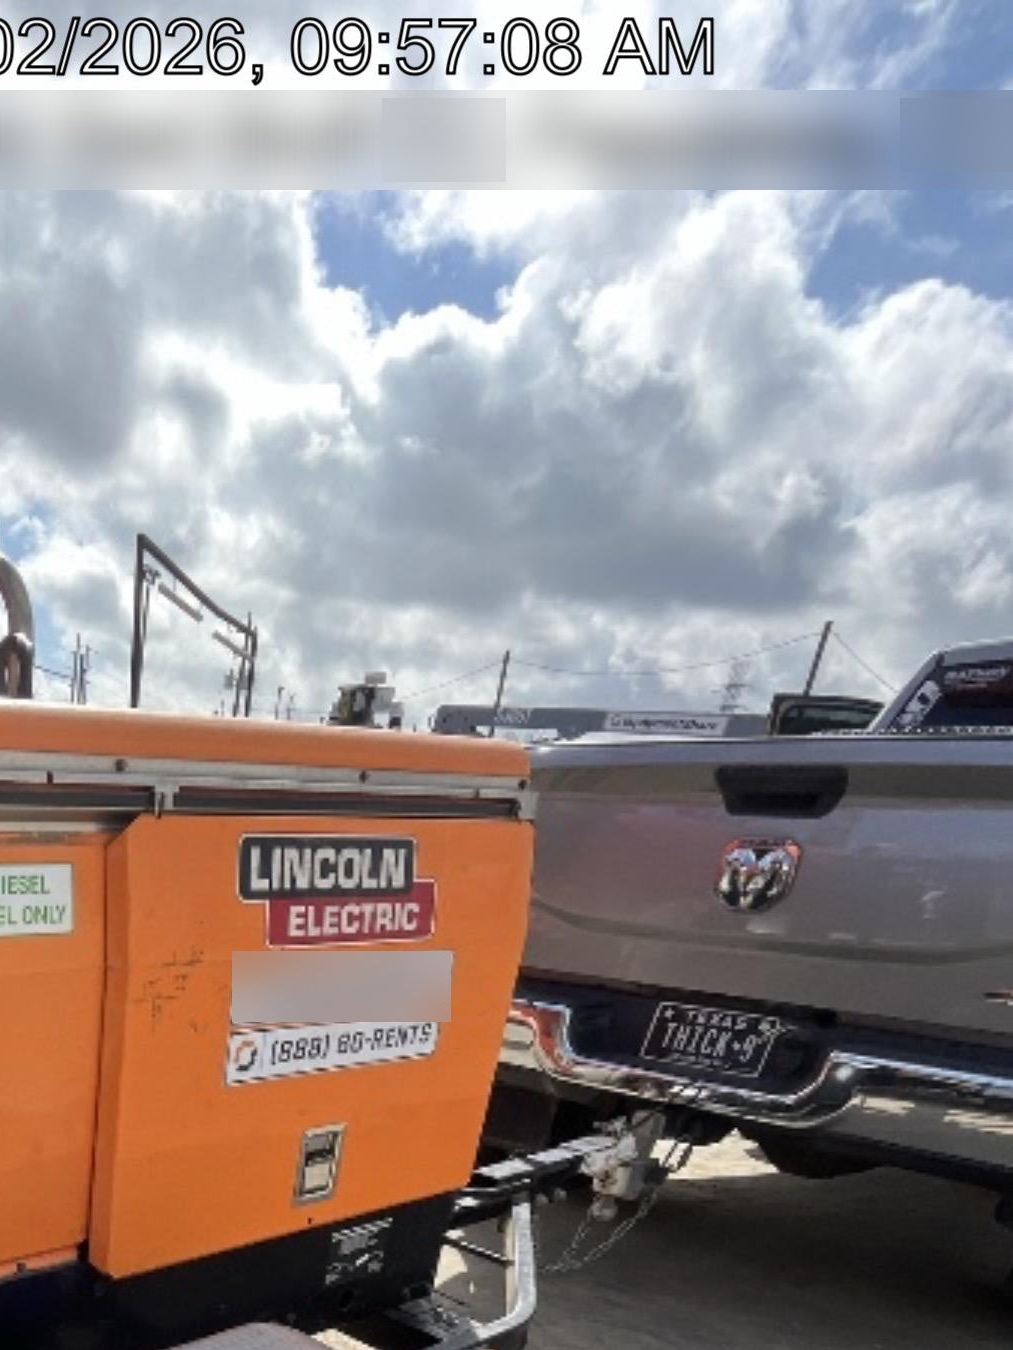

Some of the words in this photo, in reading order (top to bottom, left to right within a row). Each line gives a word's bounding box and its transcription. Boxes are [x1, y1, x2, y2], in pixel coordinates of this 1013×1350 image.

[249, 845, 408, 892] LINCOLN
[21, 905, 66, 925] ONLY
[288, 902, 421, 937] ELECTRIC
[270, 1034, 330, 1066] (888)
